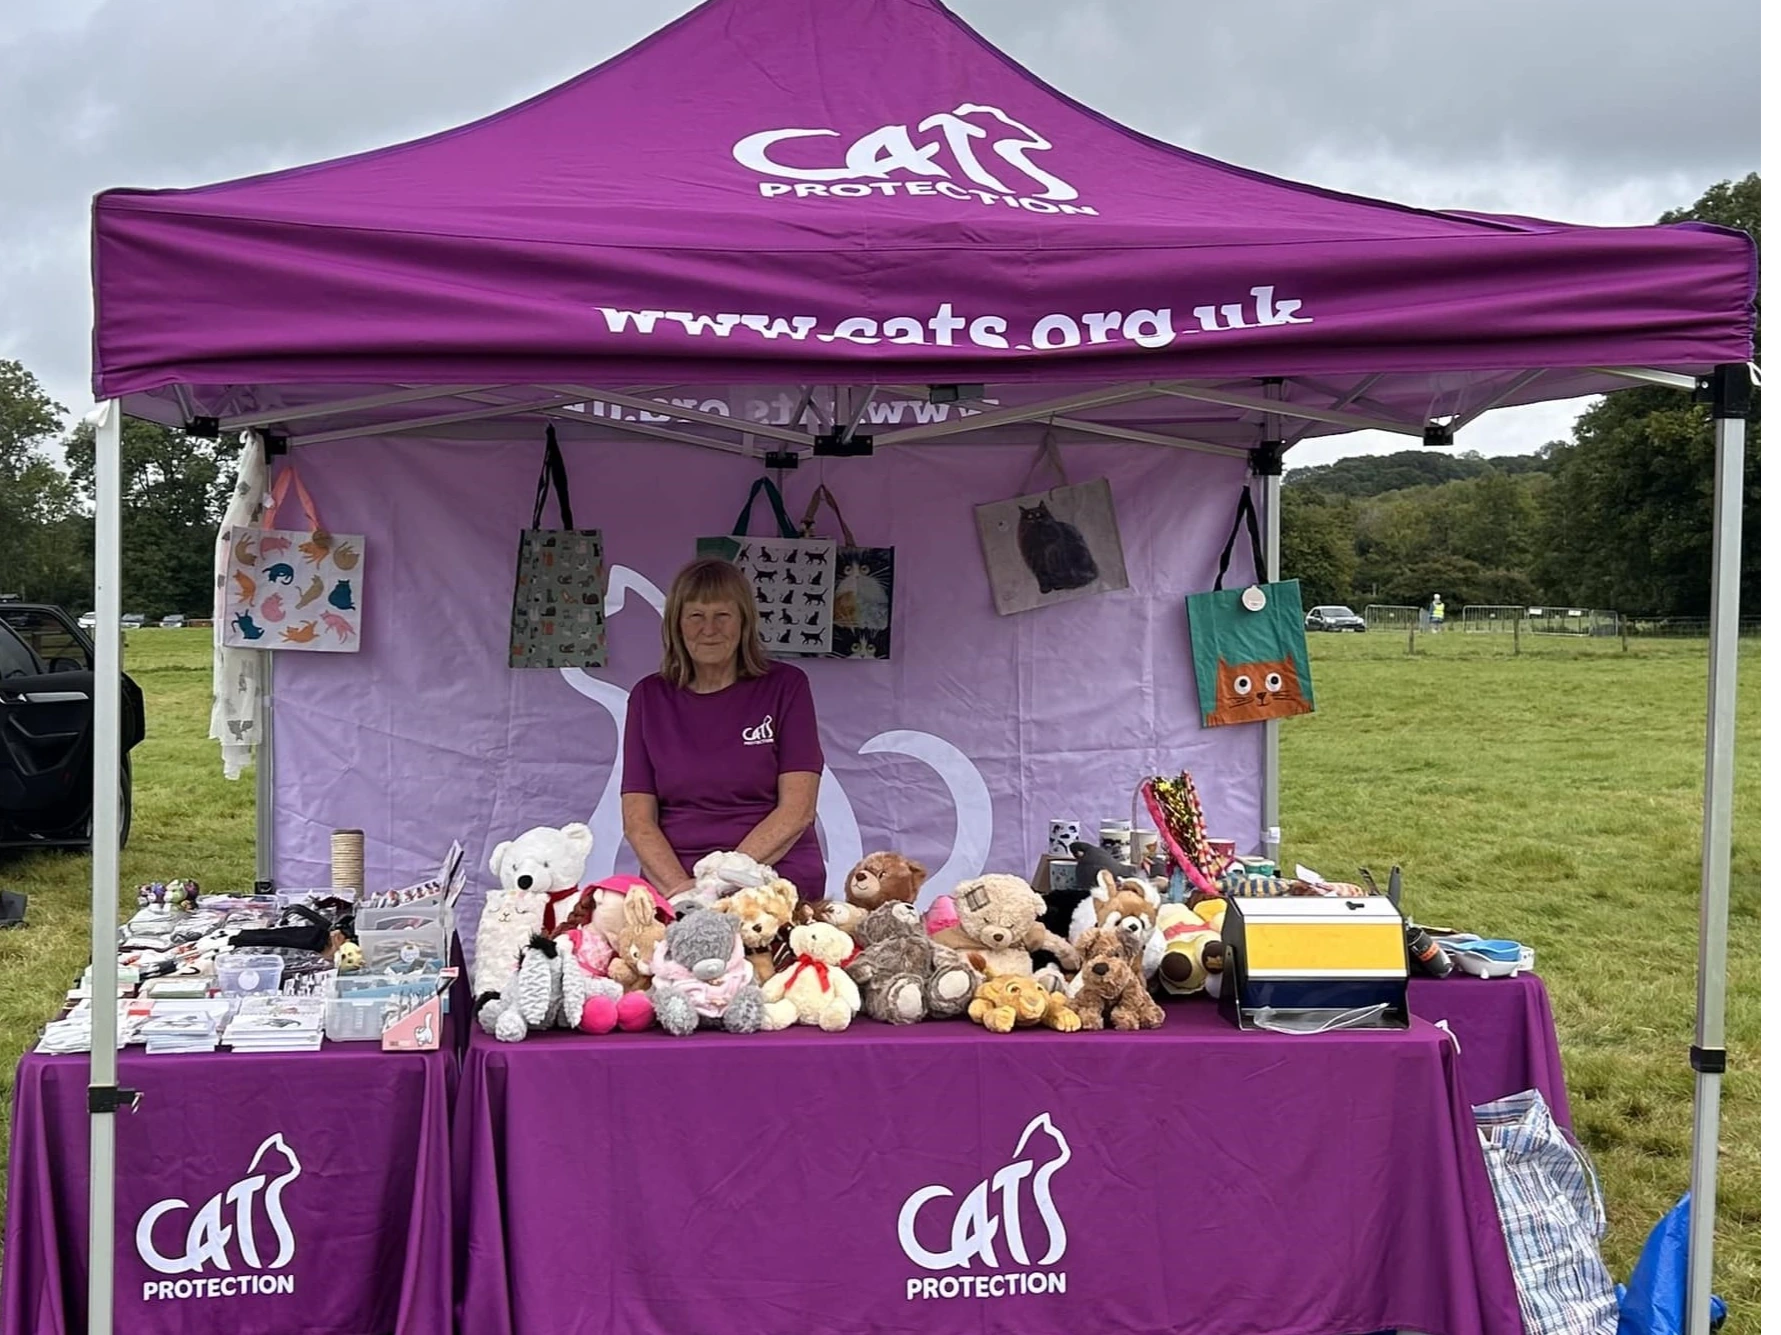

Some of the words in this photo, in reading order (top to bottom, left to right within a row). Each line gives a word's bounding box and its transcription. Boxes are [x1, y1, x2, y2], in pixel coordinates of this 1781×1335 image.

[732, 103, 1079, 201] CATS
[759, 181, 1100, 216] PROTECTION
[593, 286, 1314, 350] wwwcatsorguk
[742, 714, 774, 741] CATS
[135, 1132, 302, 1274] CATS
[897, 1112, 1072, 1270] CATS
[143, 1274, 295, 1301] PROTECTION
[906, 1271, 1067, 1301] PROTECTION
